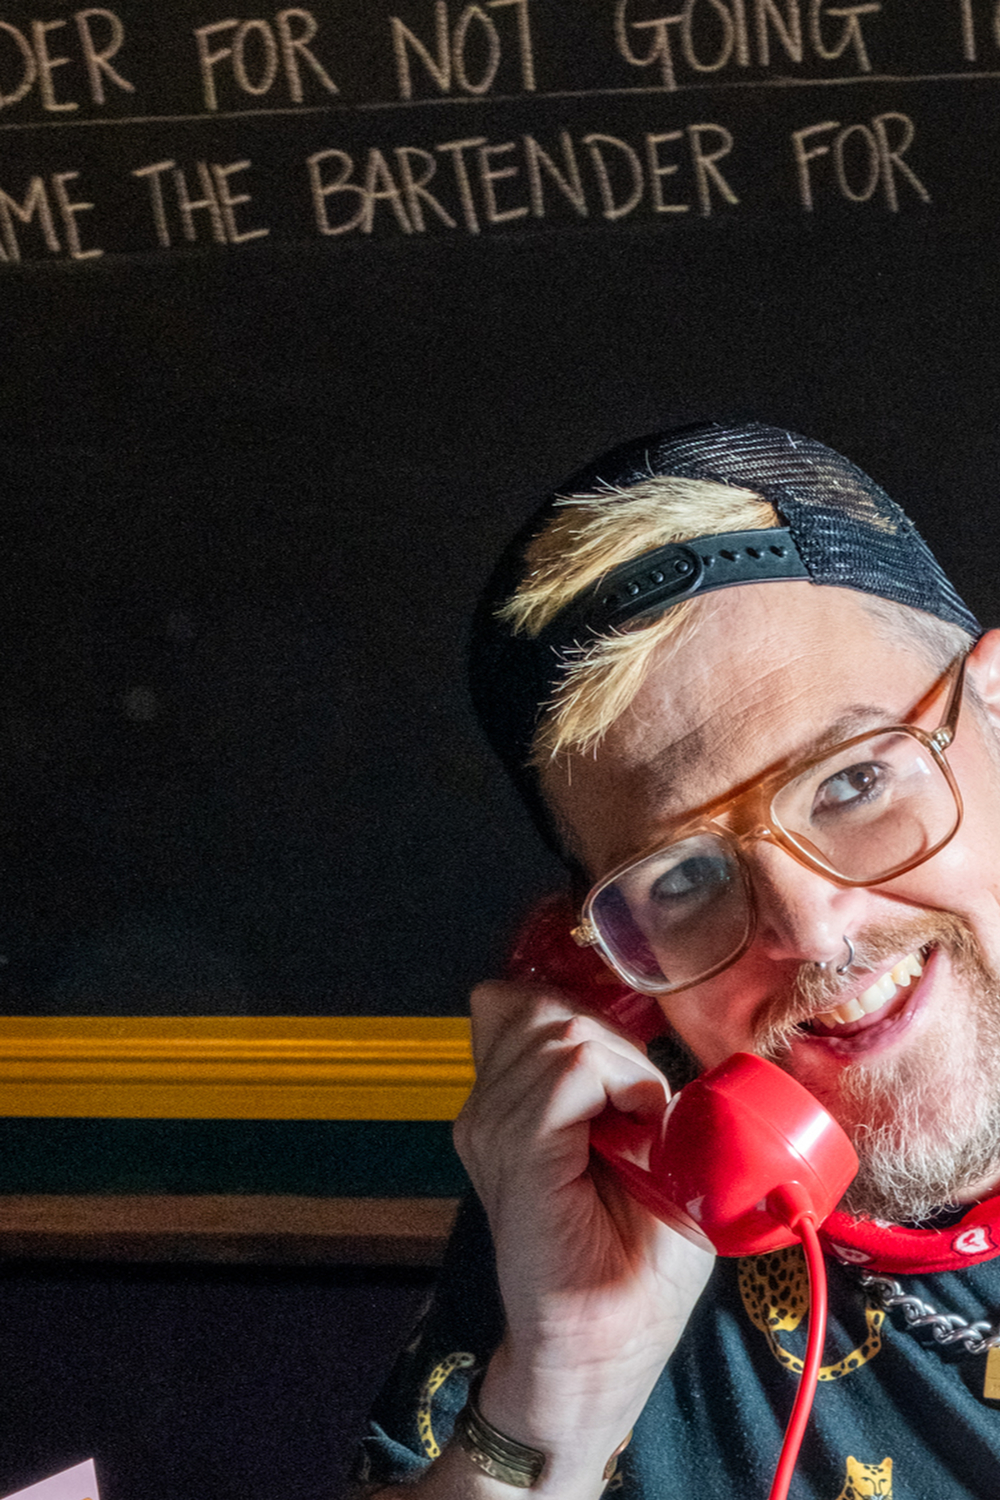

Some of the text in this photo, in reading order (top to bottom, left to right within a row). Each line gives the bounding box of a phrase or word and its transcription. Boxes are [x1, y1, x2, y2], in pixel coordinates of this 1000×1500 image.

[195, 8, 339, 111] FOR
[390, 0, 537, 99] NOT
[615, 0, 882, 91] GOING
[0, 112, 932, 264] ME THE BARTENDER FOR
